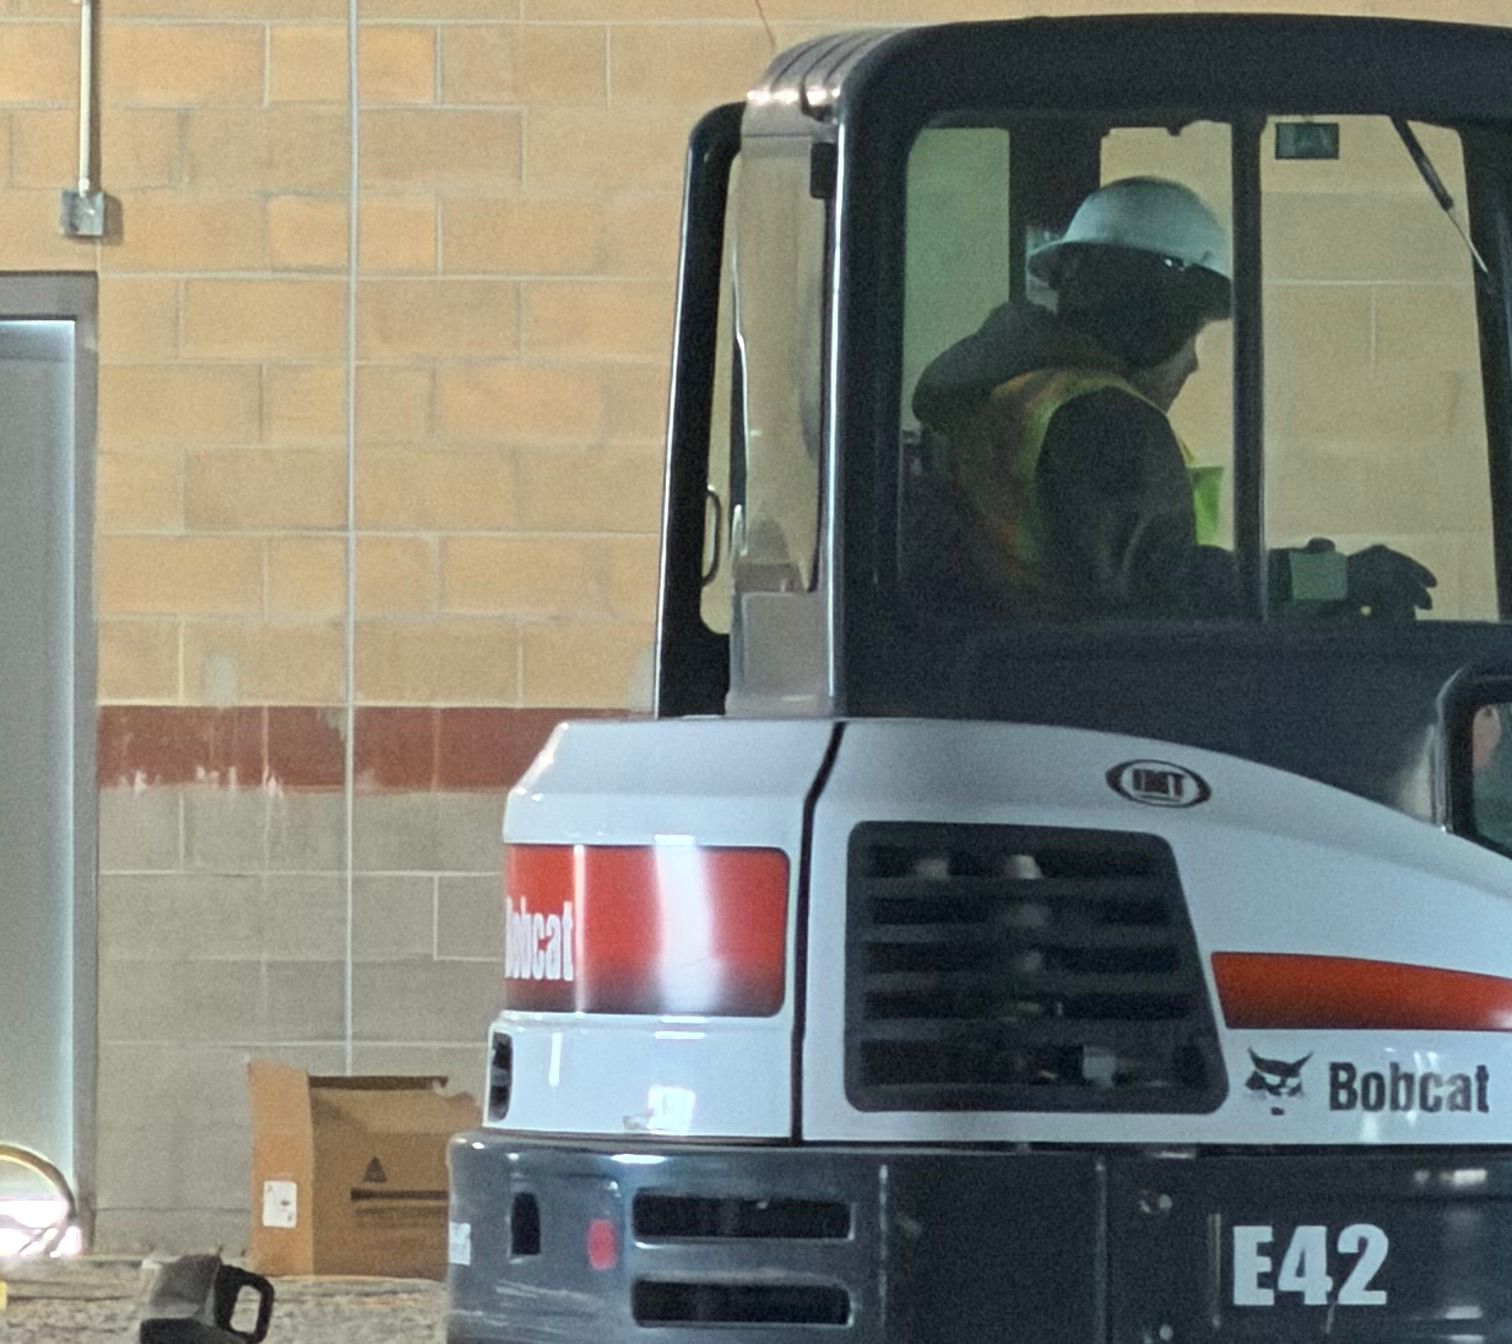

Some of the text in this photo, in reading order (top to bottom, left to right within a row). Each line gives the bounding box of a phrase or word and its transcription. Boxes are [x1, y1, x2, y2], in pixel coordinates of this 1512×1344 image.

[1133, 769, 1184, 797] IMT
[1329, 1062, 1489, 1113] Bobcat
[1233, 1224, 1389, 1305] E42
